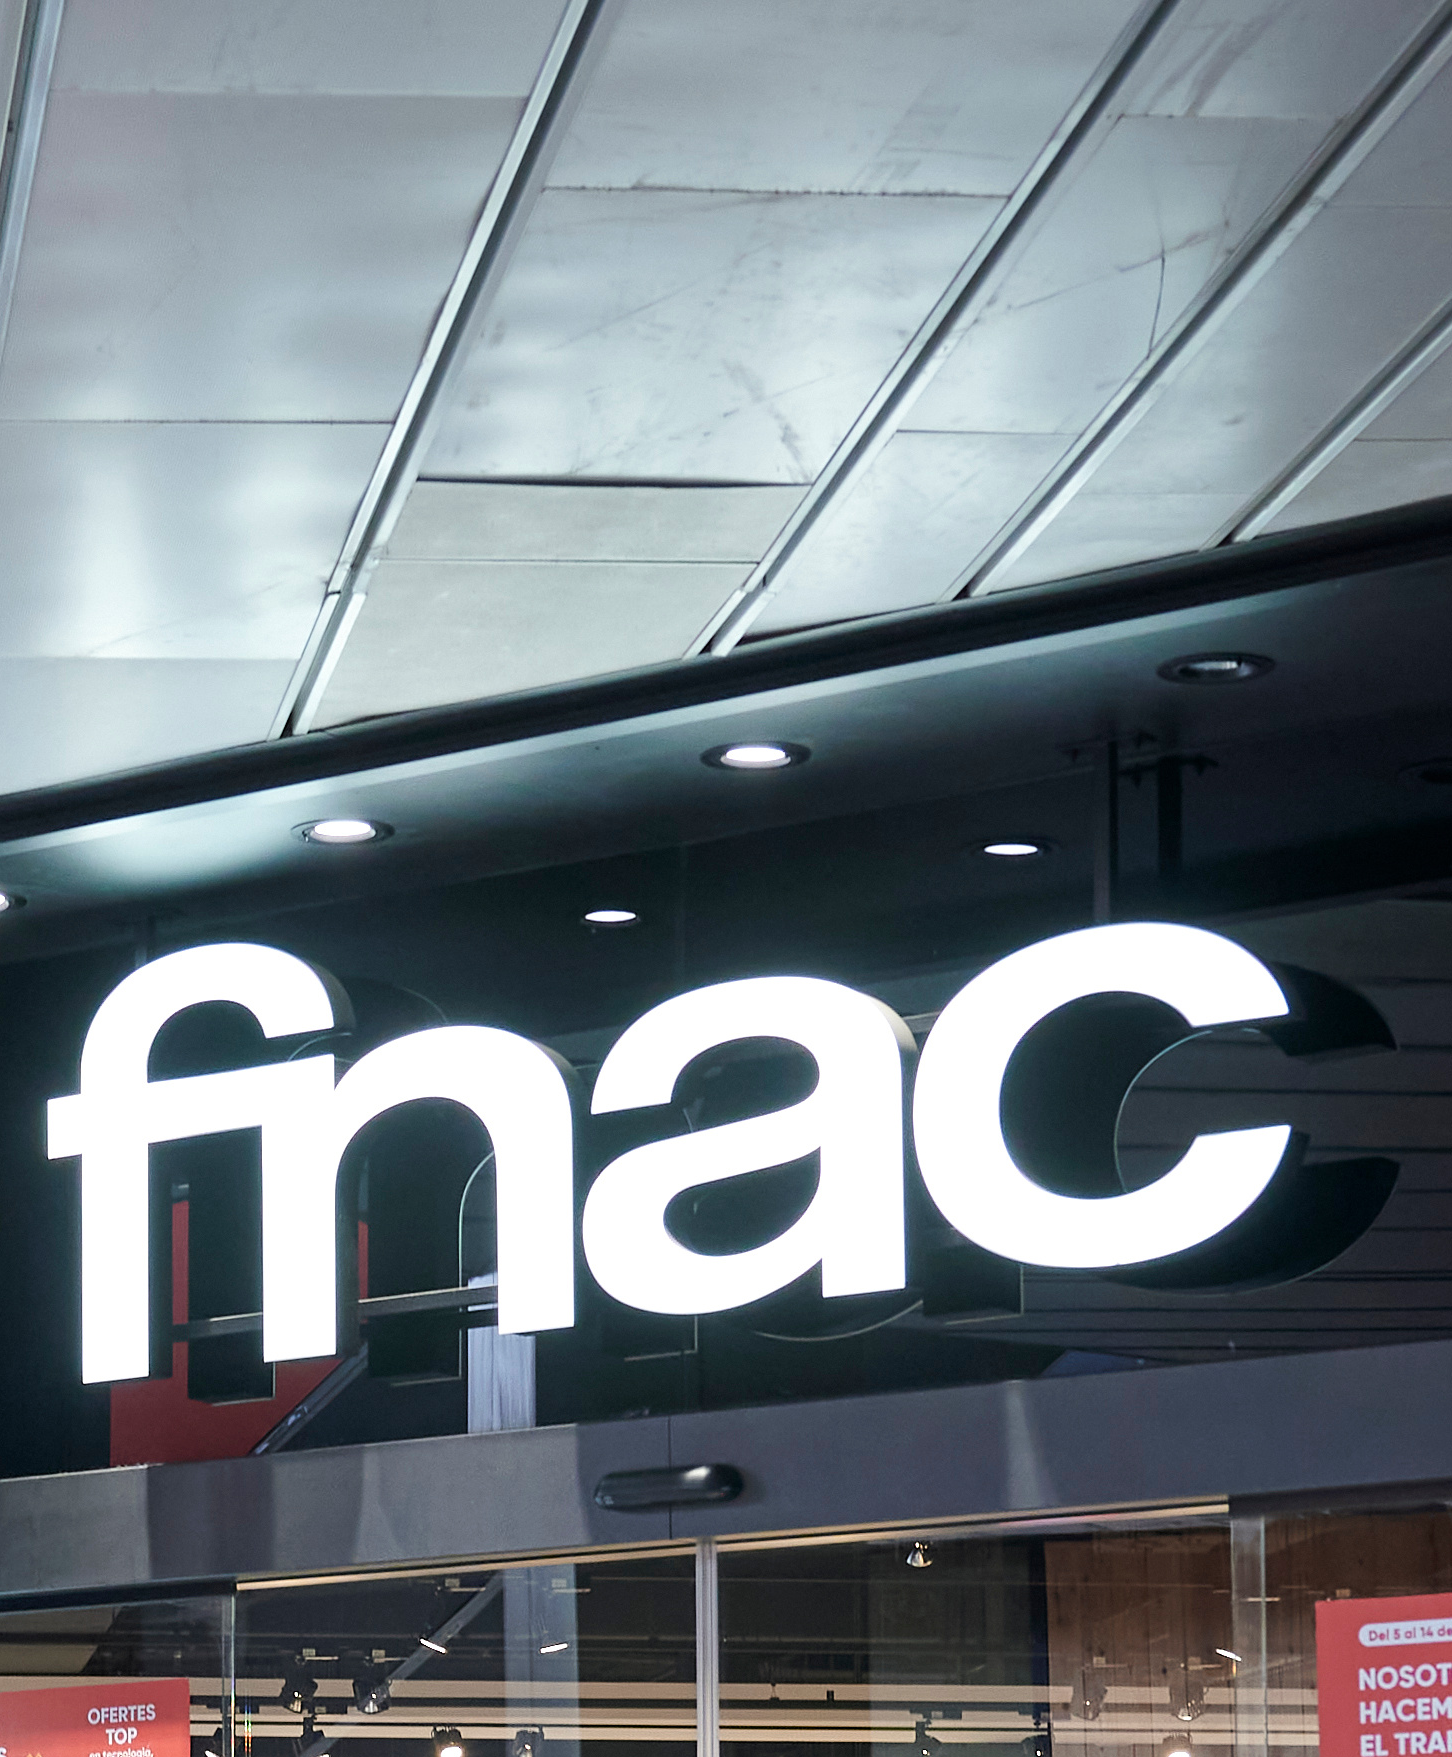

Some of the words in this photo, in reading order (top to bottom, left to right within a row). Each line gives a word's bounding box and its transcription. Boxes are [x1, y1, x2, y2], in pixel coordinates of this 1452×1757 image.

[45, 920, 1294, 1386] fnac
[1368, 1629, 1389, 1642] Del
[1394, 1628, 1400, 1640] 5
[1405, 1627, 1417, 1639] al
[1421, 1626, 1433, 1638] 14
[1438, 1624, 1452, 1637] de
[88, 1704, 156, 1724] OFERTES
[106, 1727, 137, 1745] TOP
[1360, 1734, 1388, 1757] EL
